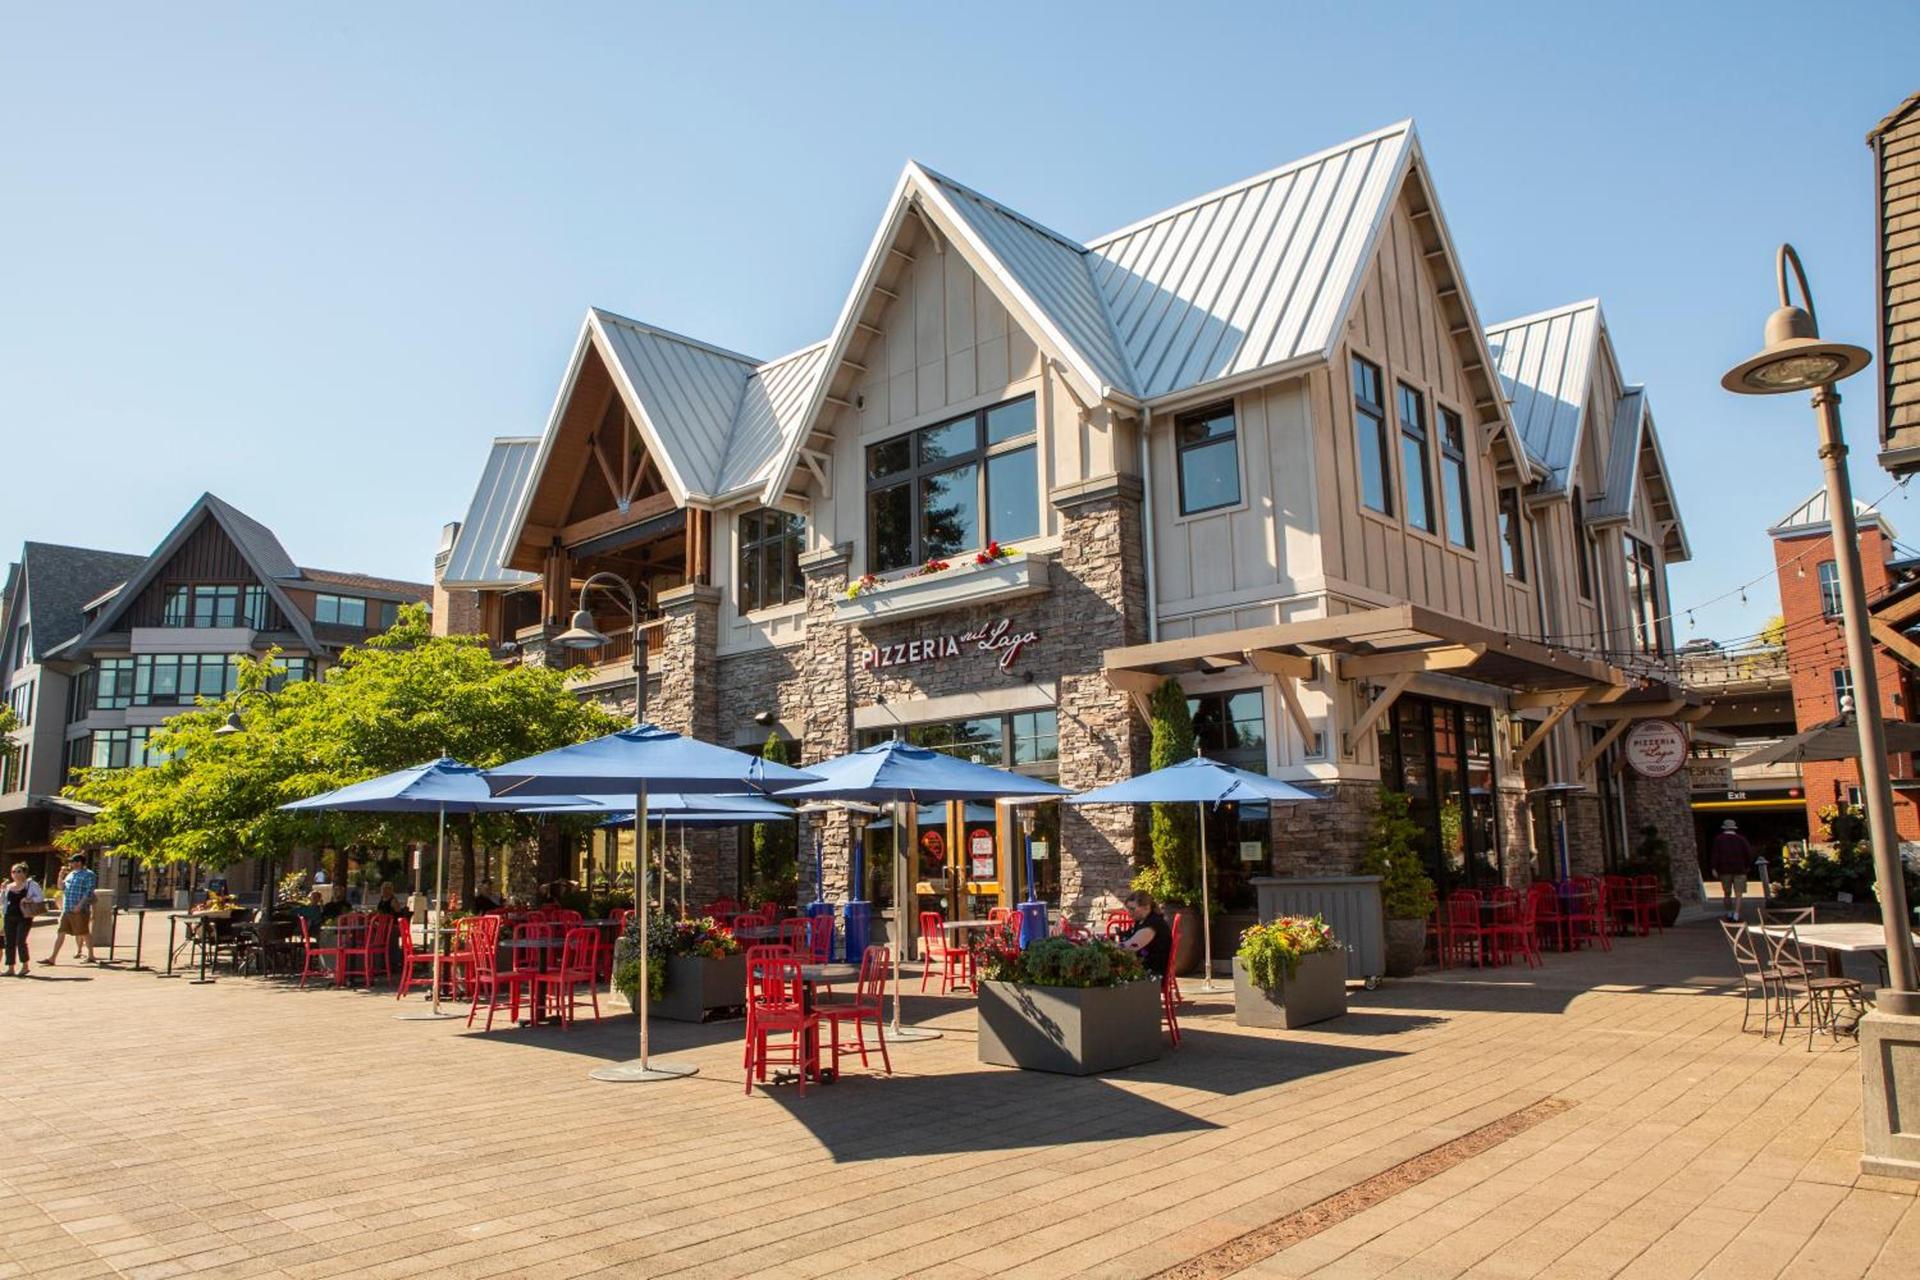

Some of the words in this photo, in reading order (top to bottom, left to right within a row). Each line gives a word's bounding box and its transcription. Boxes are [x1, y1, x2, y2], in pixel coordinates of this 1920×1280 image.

[862, 635, 960, 670] PIZZERIA
[960, 623, 986, 643] sul
[977, 618, 1039, 671] Lago
[1633, 738, 1675, 746] PIZZERIA
[1727, 791, 1747, 800] Exit
